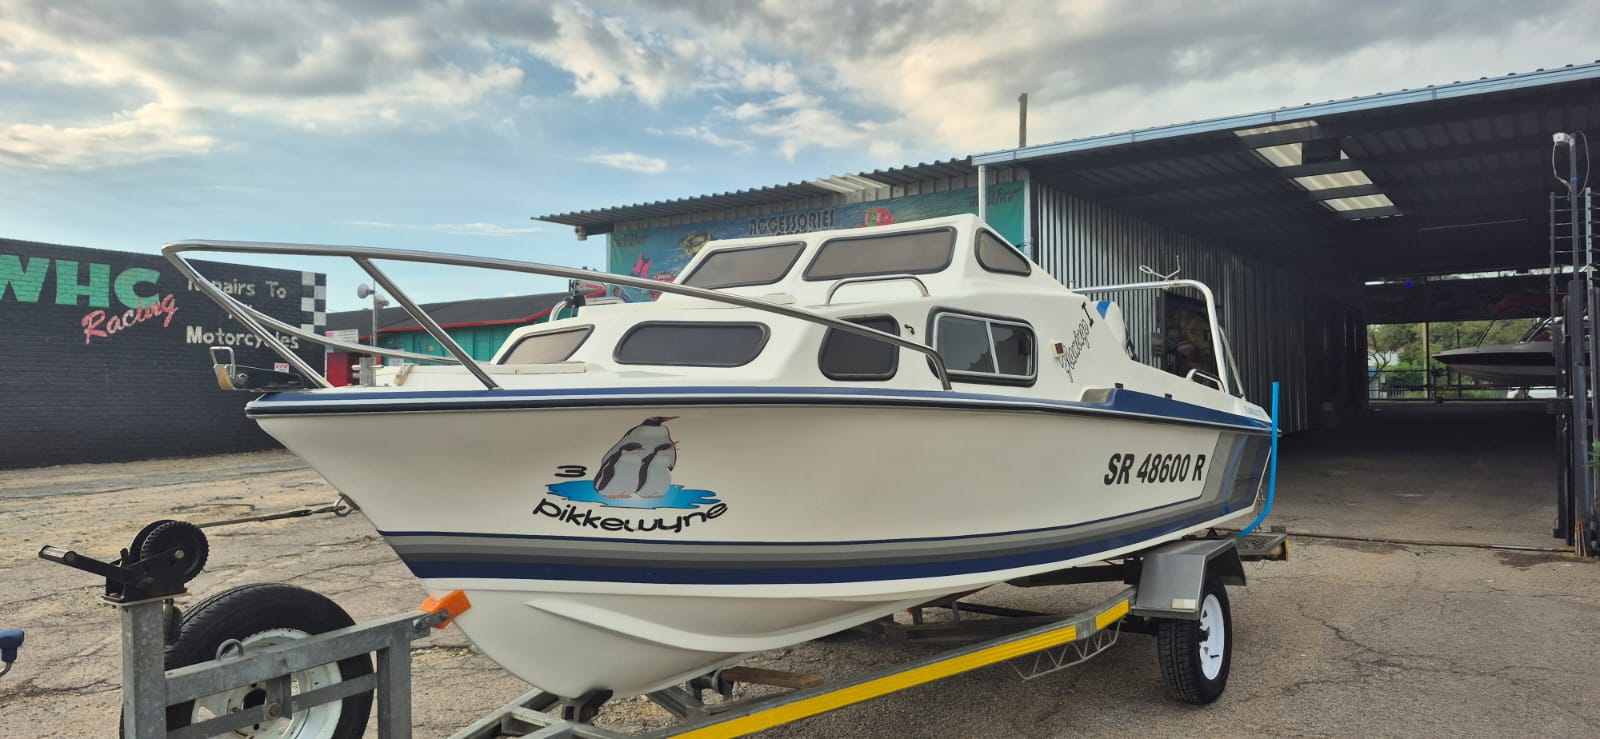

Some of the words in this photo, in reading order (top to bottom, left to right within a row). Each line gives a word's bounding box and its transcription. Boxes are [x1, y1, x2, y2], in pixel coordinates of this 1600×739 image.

[749, 208, 835, 235] ACCESSORIES
[0, 254, 161, 310] WHC
[265, 280, 288, 299] To
[81, 293, 178, 345] Racing
[554, 464, 588, 478] 3
[1103, 452, 1135, 486] SR
[1136, 452, 1191, 485] 48600
[1192, 453, 1207, 482] R
